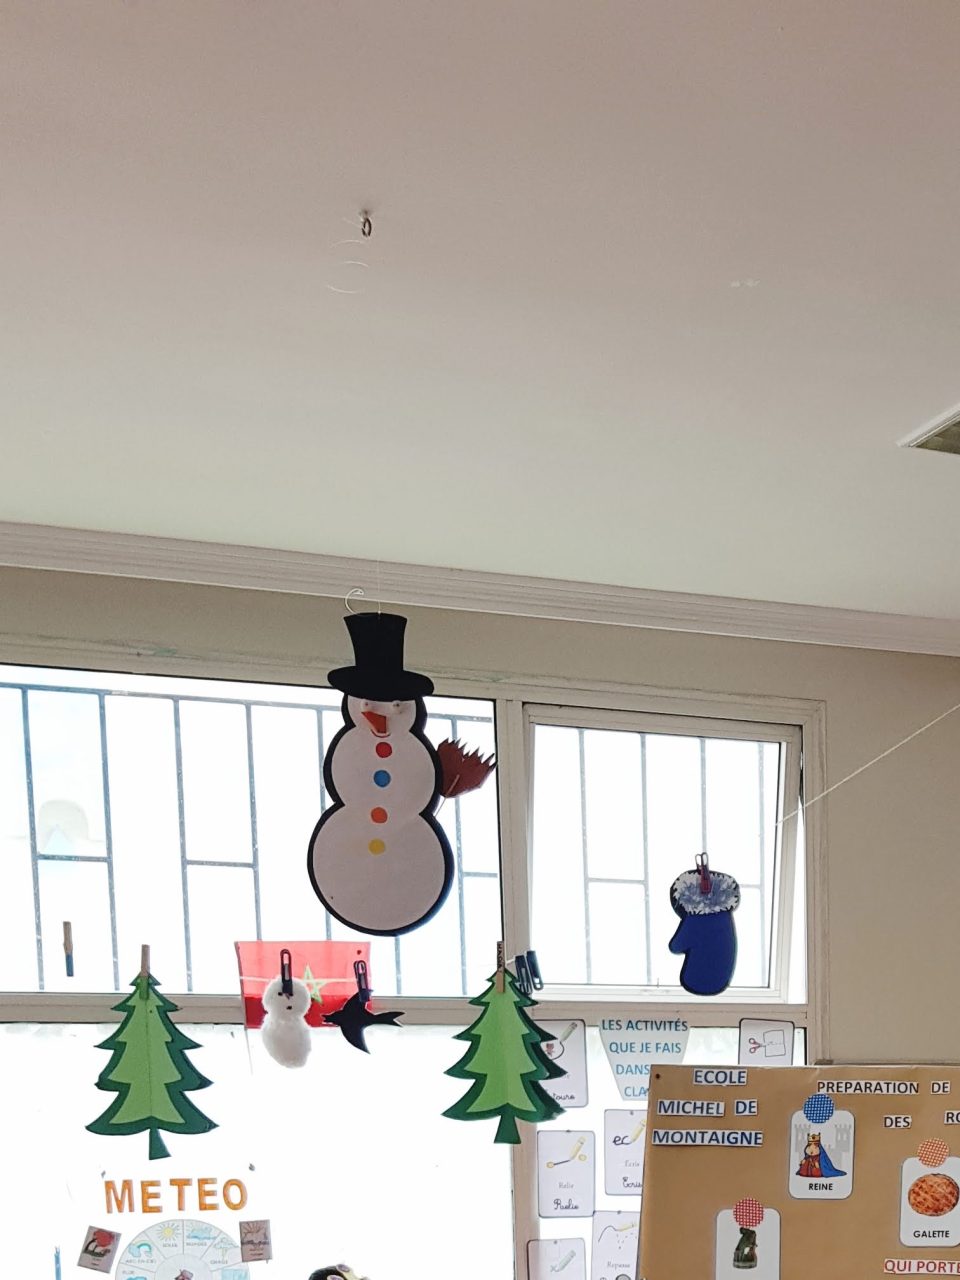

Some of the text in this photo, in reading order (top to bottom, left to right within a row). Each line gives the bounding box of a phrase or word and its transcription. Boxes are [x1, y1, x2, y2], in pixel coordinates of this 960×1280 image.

[602, 1018, 688, 1032] LES ACTIVITÉS
[609, 1042, 682, 1054] QUE JE FAIS
[616, 1064, 650, 1075] DANS
[694, 1070, 746, 1084] ECOLE
[624, 1086, 648, 1097] CLA
[817, 1082, 919, 1093] PREPARATION
[931, 1082, 949, 1093] DE
[658, 1100, 756, 1115] MICHEL DE
[884, 1116, 910, 1128] DES
[652, 1130, 764, 1146] MONTAIGNE
[808, 1183, 834, 1191] REINE
[104, 1177, 248, 1214] METEO
[913, 1230, 950, 1239] GALETTE
[884, 1260, 912, 1275] QUI
